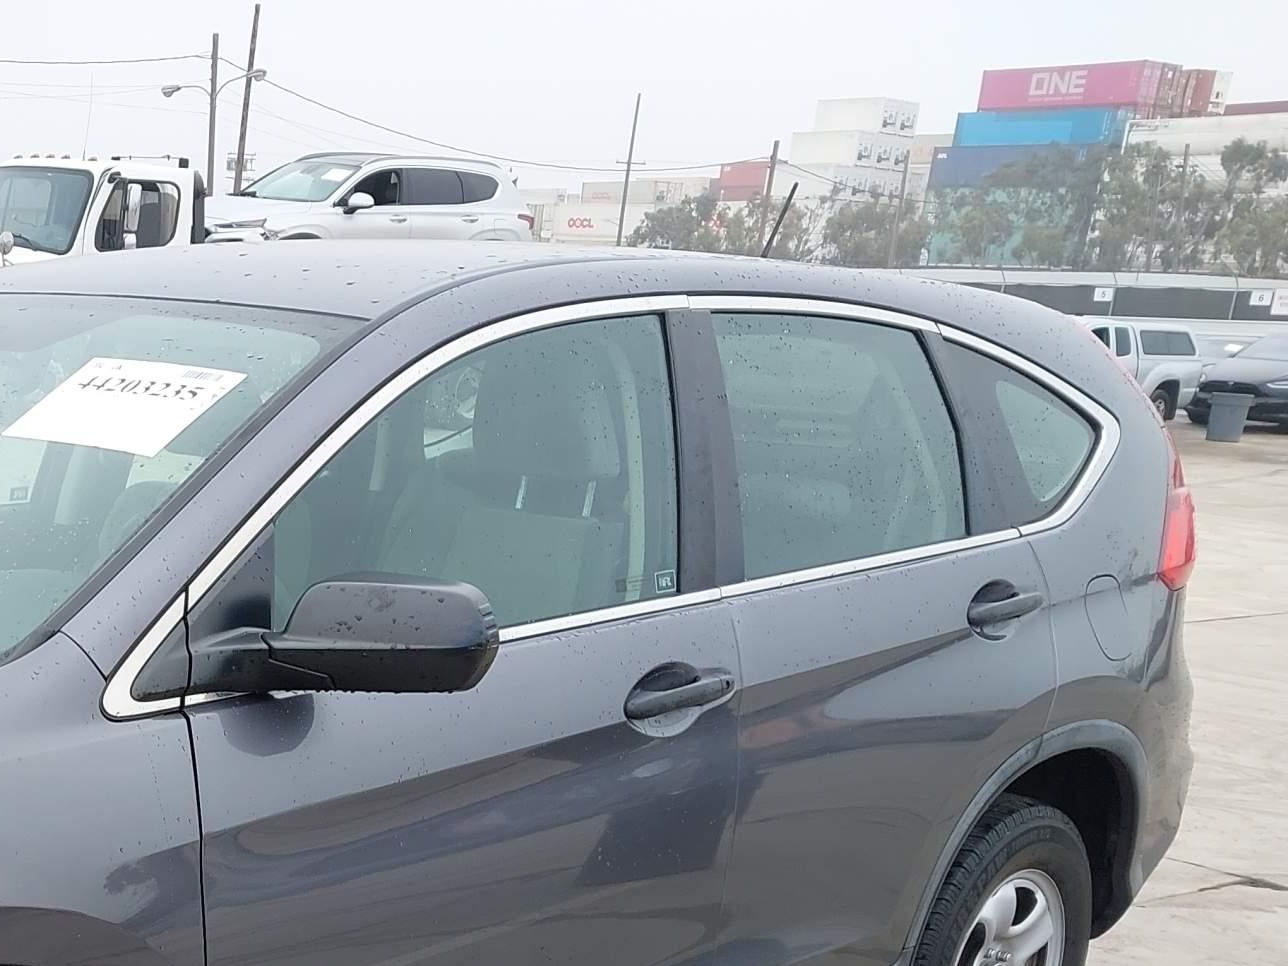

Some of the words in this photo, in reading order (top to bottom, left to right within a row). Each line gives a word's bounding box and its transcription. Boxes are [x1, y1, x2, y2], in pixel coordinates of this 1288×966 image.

[1028, 70, 1088, 96] ONE
[568, 217, 594, 228] OOCL
[1258, 294, 1265, 302] 6
[78, 375, 205, 401] 44203235
